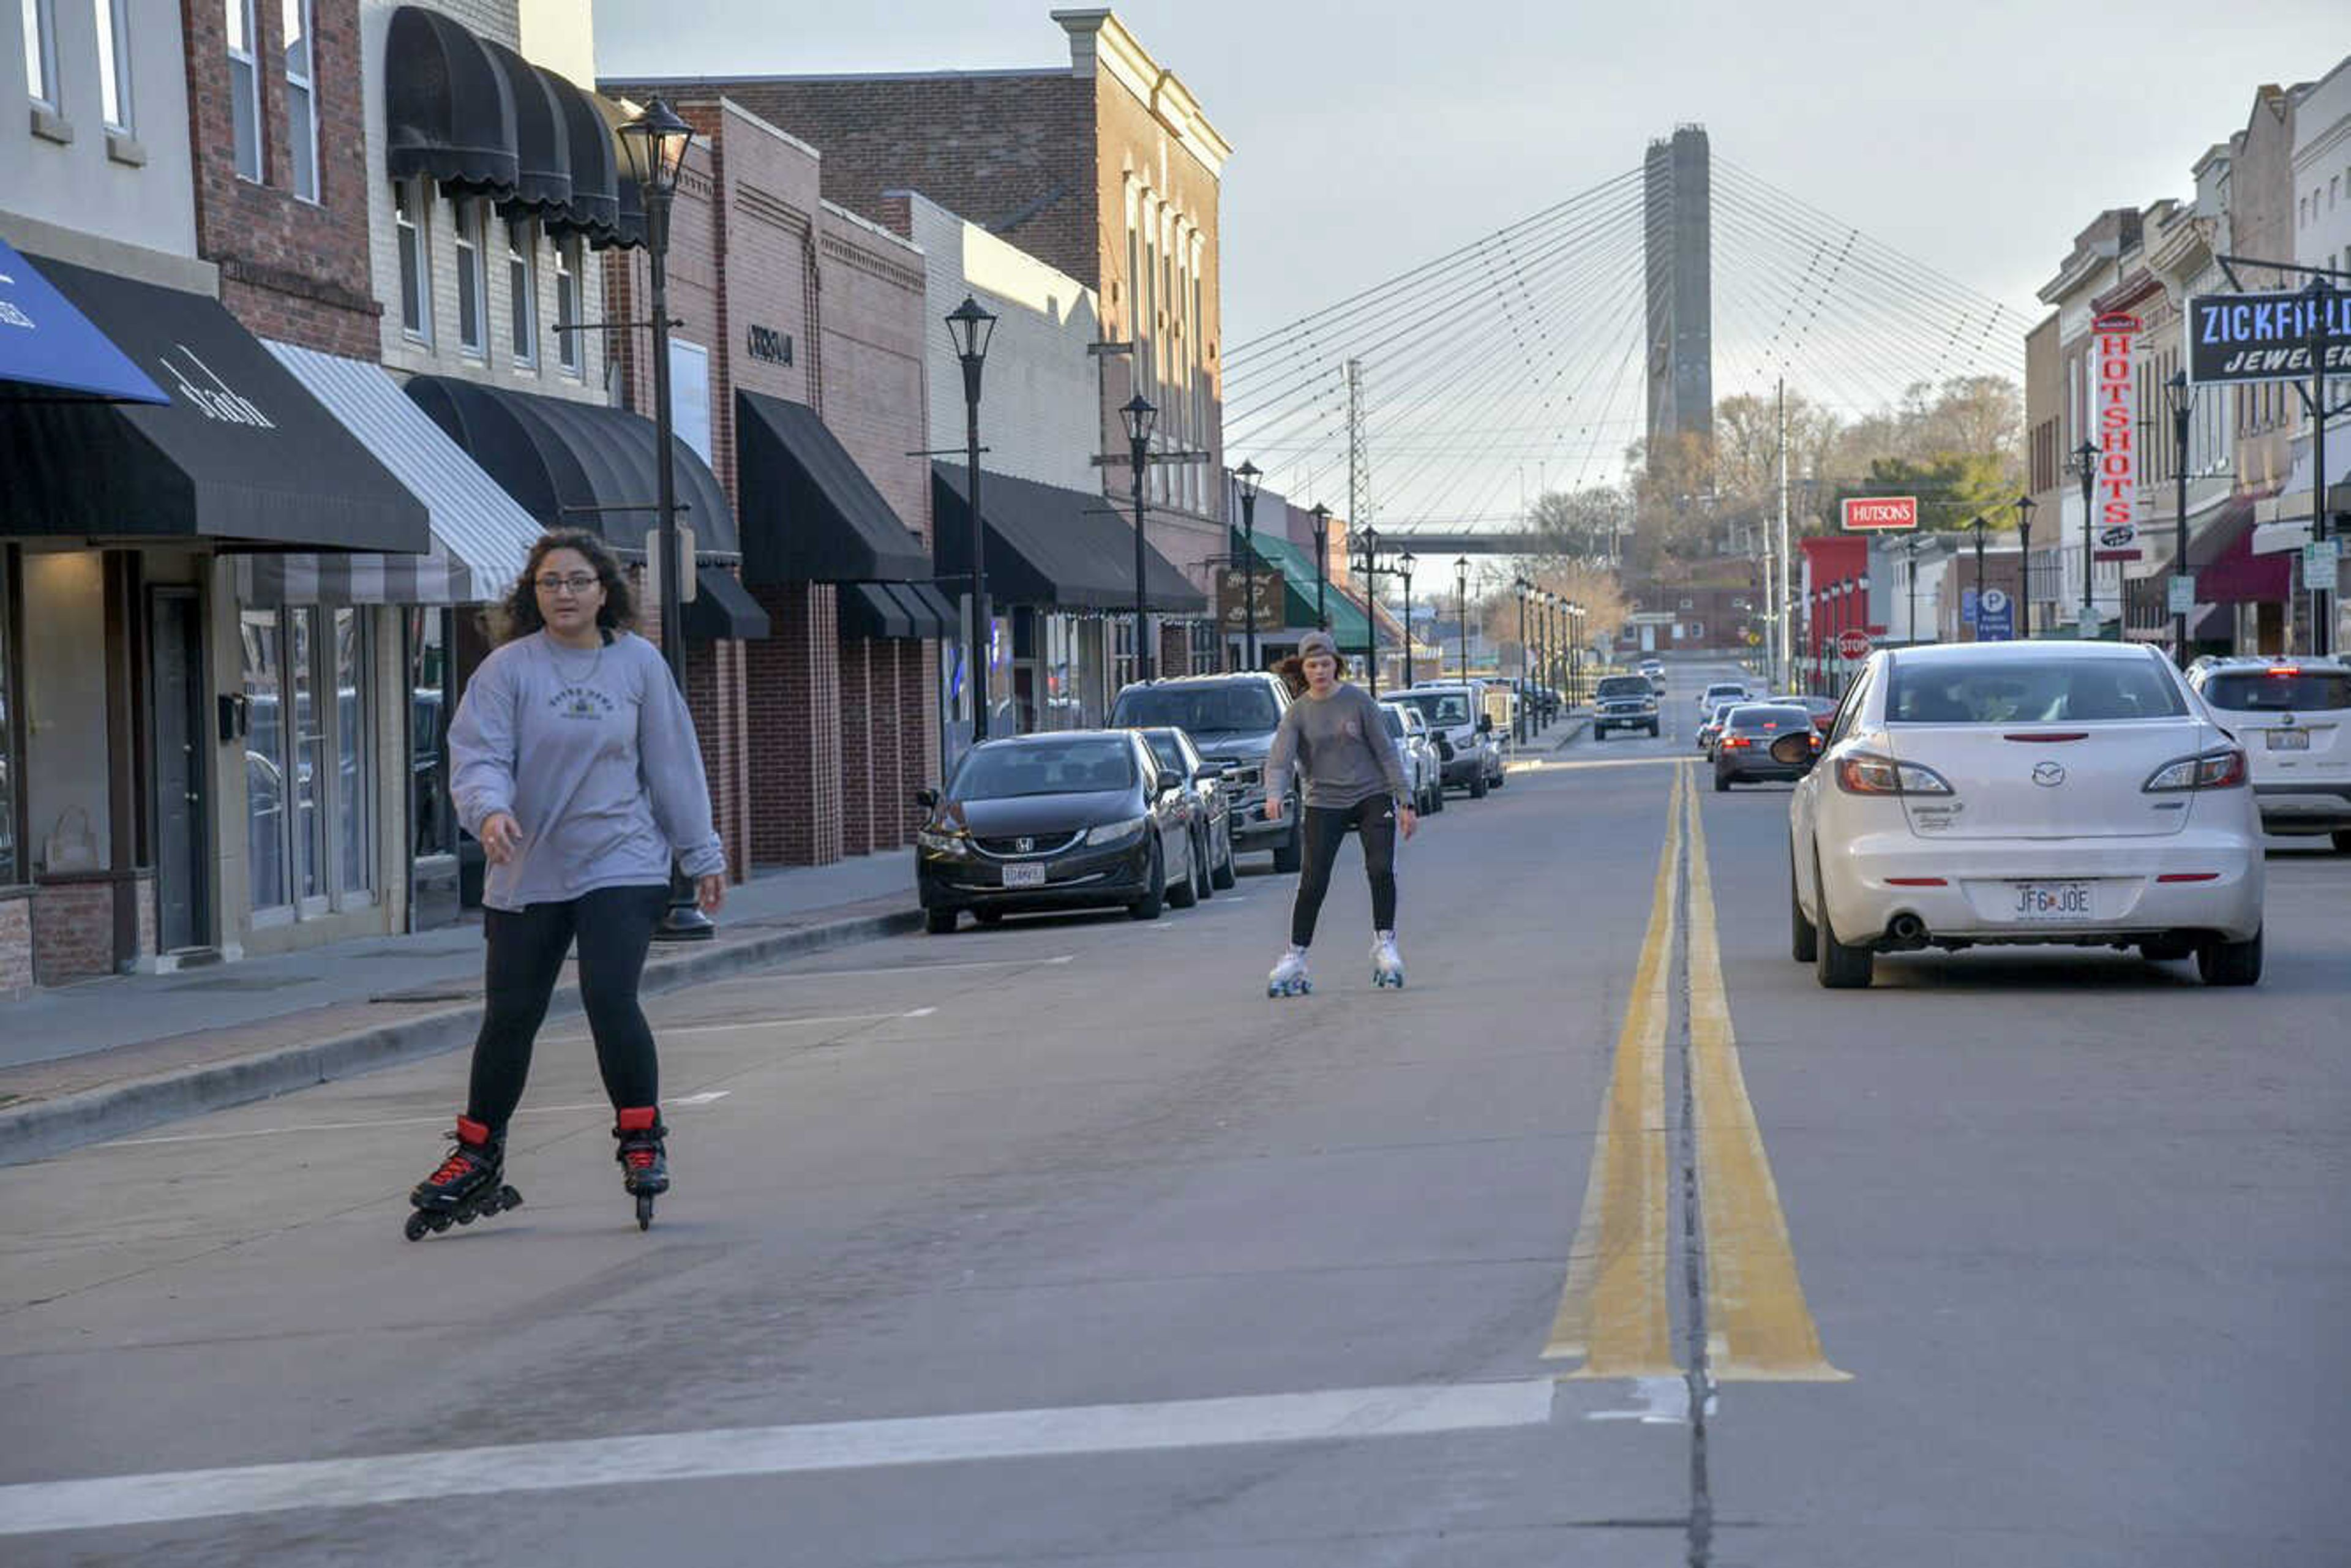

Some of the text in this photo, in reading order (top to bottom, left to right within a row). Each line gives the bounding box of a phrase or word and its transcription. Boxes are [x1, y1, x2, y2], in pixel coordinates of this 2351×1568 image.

[2101, 335, 2131, 523] HOTSHOTS
[1853, 503, 1911, 522] HUTSON'S
[1841, 639, 1868, 652] STOP
[2017, 890, 2047, 912] JF6
